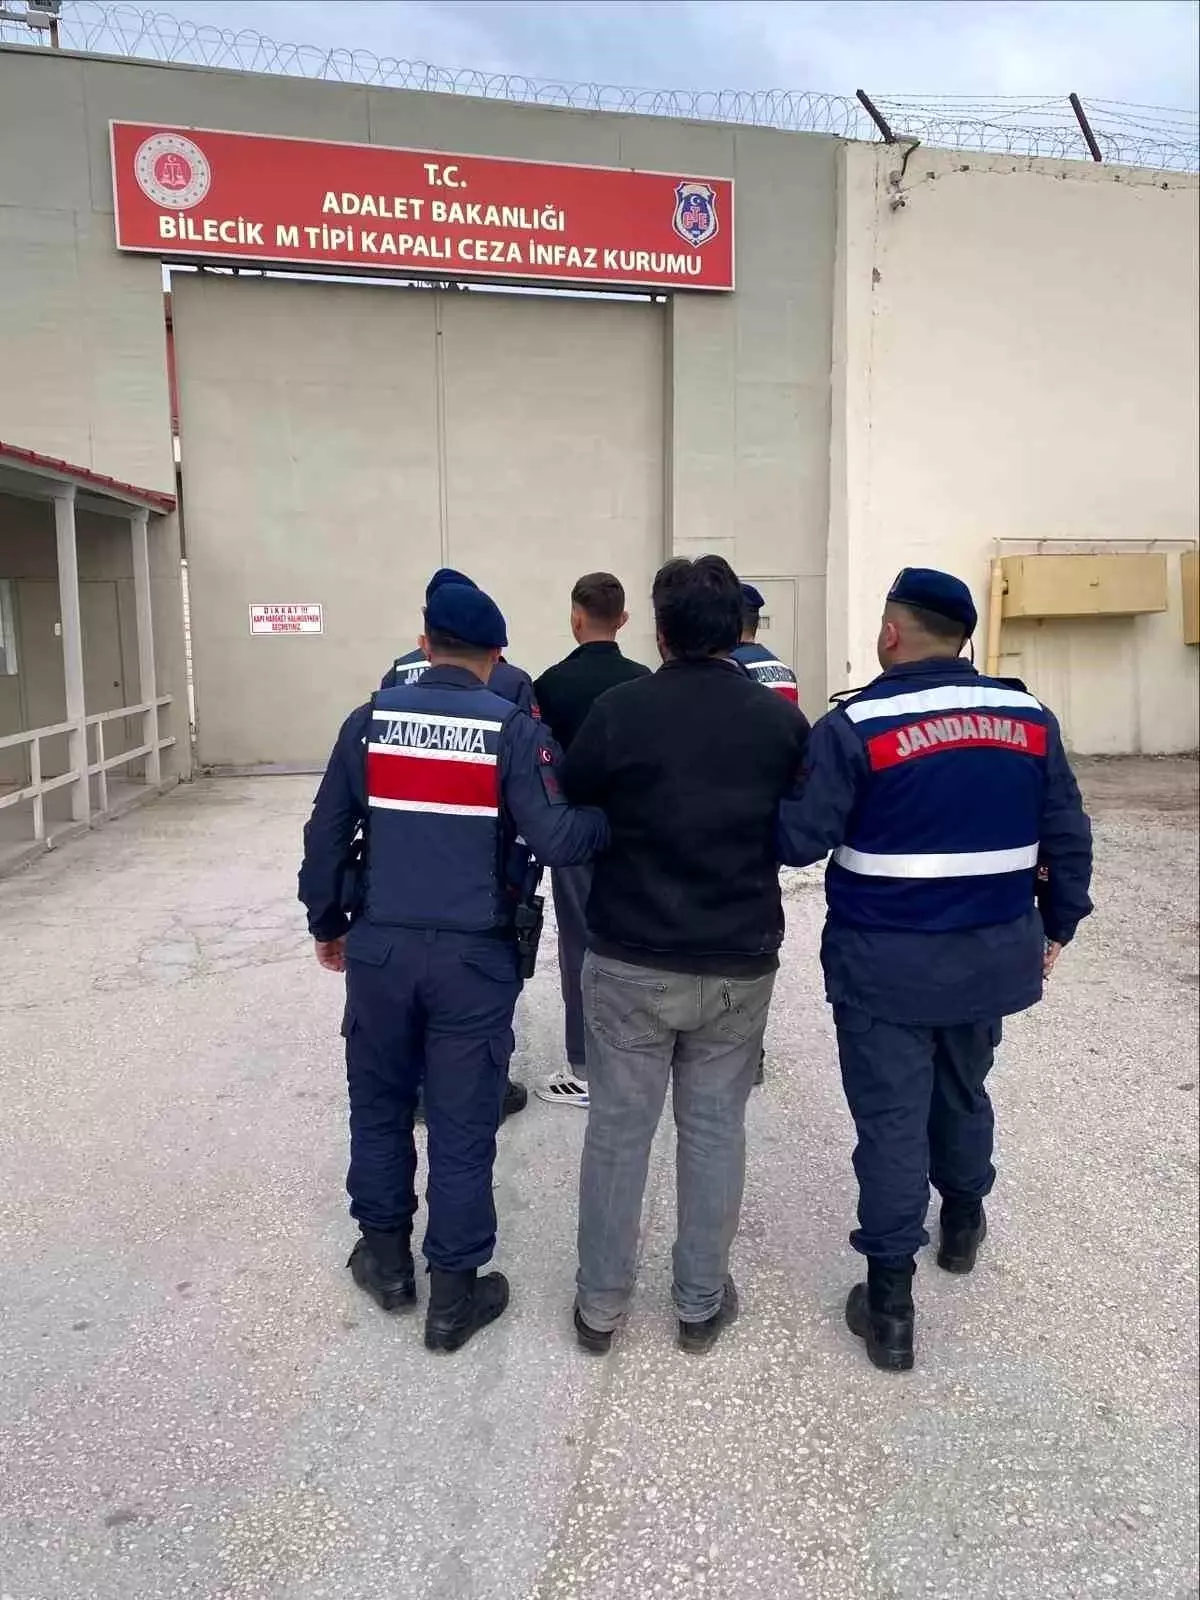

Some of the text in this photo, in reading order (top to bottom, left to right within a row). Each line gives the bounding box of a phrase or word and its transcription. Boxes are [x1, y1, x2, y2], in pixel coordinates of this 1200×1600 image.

[423, 163, 467, 188] T.C.
[322, 191, 565, 232] ADALET BAKANLIĞI
[159, 212, 702, 275] BİLECİK M TİPİ KAPALI CEZA İNFAZ KURUMU
[379, 719, 486, 753] JANDARMA
[896, 715, 1028, 757] JANDARMA
